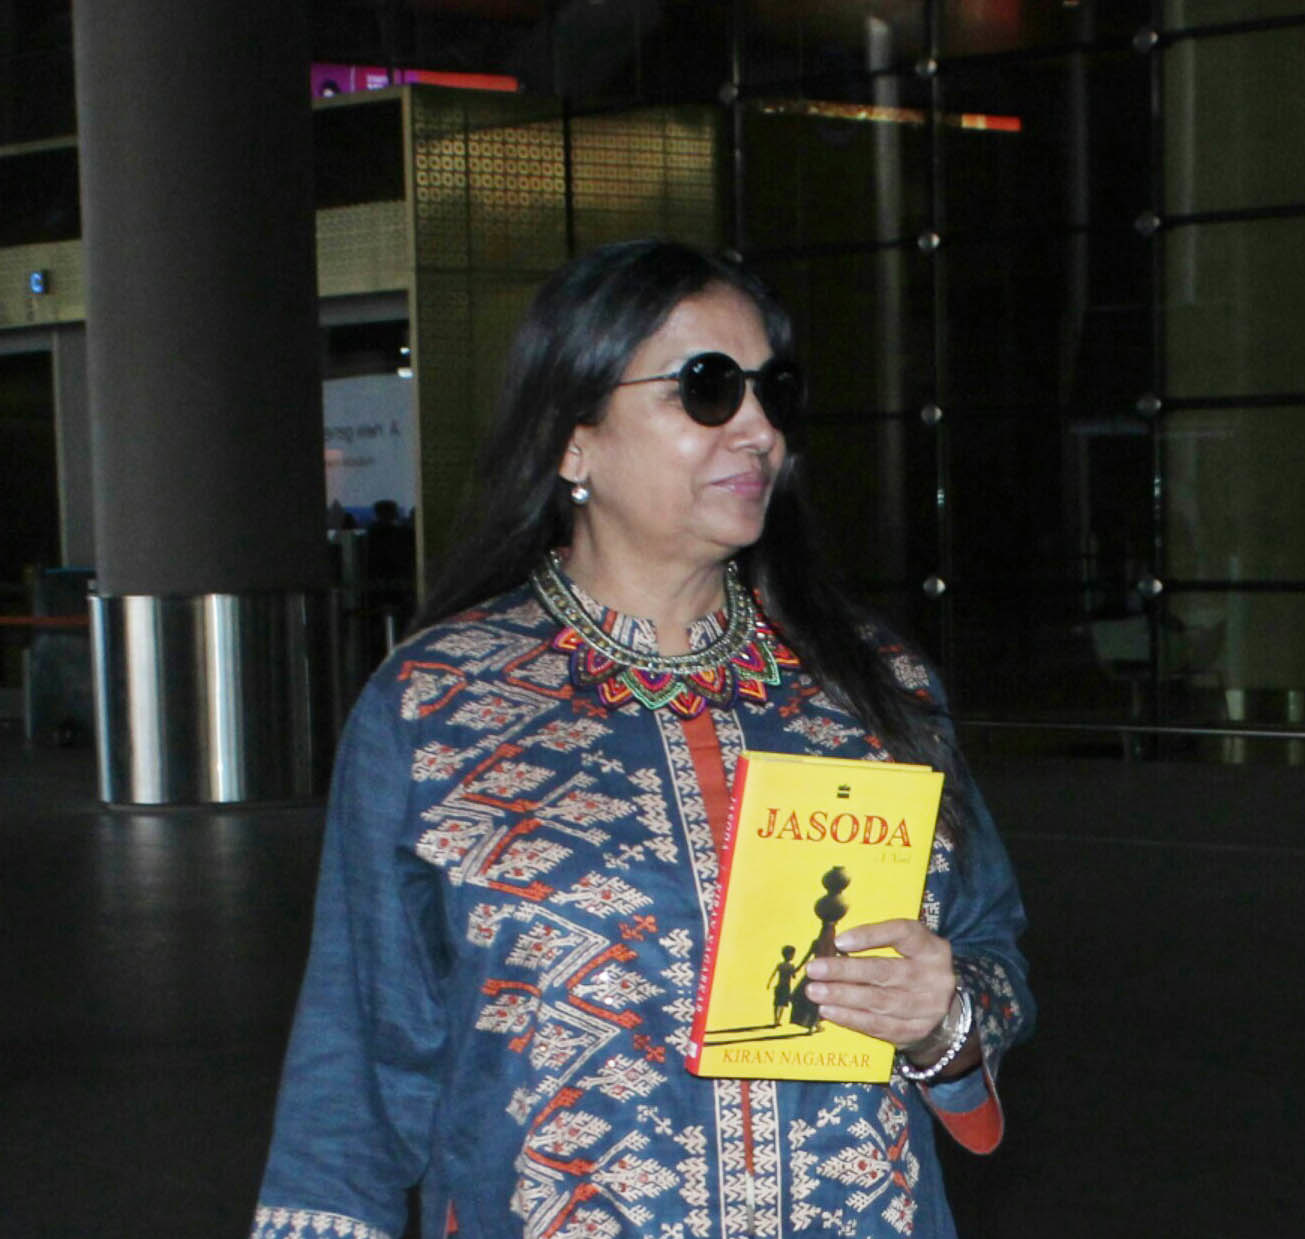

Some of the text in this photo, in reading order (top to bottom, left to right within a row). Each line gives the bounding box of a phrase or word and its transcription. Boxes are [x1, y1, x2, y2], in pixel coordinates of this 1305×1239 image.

[757, 808, 913, 847] JASODA
[721, 1049, 873, 1069] KIRAN NAGARKAR
